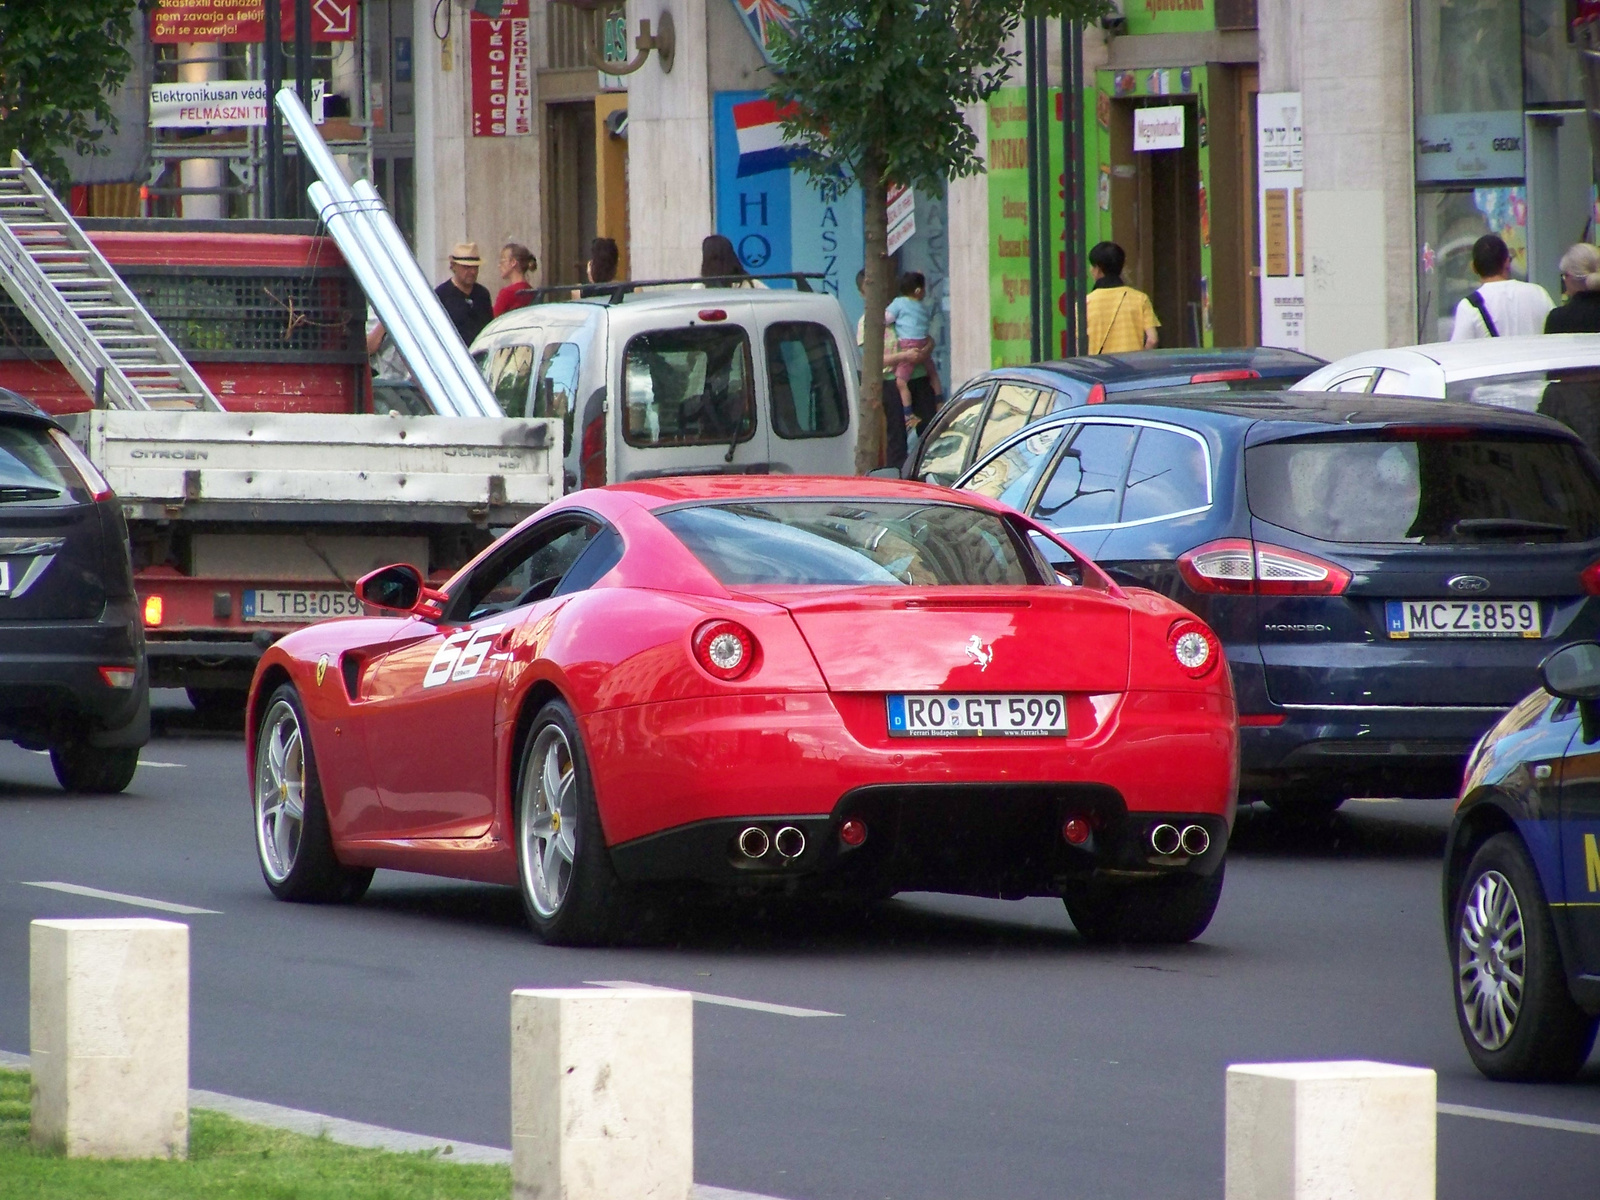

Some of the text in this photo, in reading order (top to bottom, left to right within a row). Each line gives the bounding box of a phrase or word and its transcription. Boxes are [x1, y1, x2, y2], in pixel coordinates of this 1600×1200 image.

[156, 12, 181, 21] nem
[183, 11, 224, 23] zavarja
[226, 12, 234, 21] a
[155, 24, 238, 36] Önt se zavarja!
[151, 87, 239, 103] Elektronikusan
[240, 86, 267, 100] véde
[180, 104, 250, 120] FELMÁSZNI
[1392, 619, 1401, 629] H
[422, 622, 508, 689] 66
[894, 698, 1062, 727] D RO GT 599
[931, 729, 959, 737] Budapest
[1003, 729, 1049, 737] www.ferrari.hu
